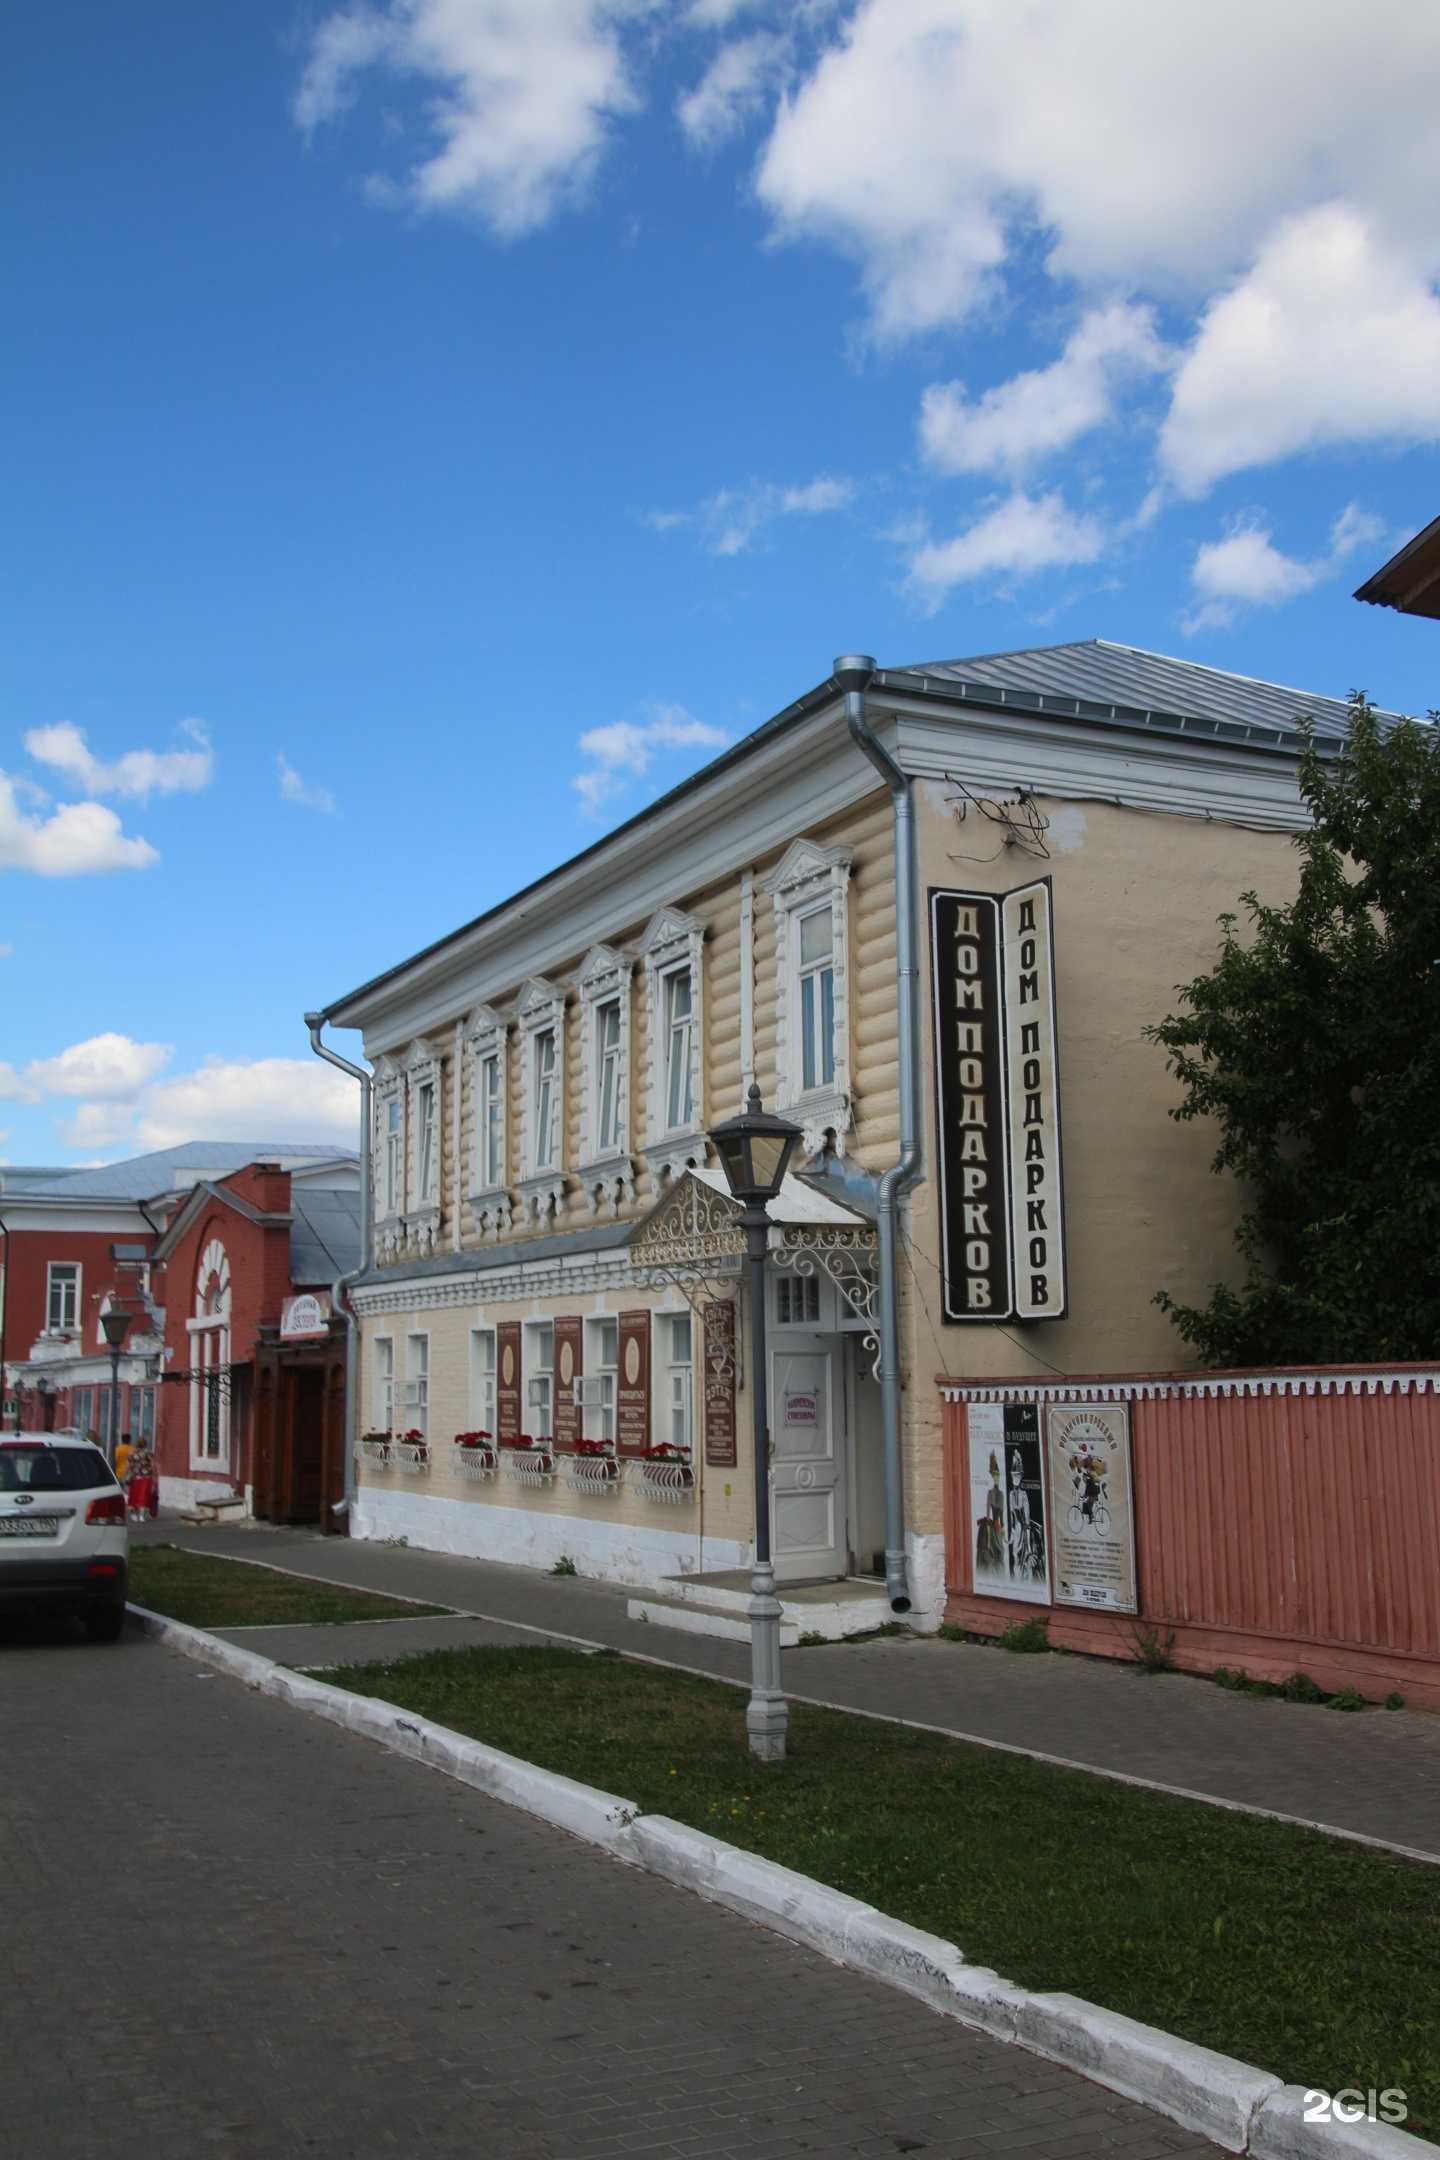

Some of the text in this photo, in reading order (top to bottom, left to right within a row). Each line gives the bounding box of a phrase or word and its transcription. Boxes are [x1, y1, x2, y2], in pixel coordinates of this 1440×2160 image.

[954, 905, 992, 1310] ДОМ ПОДАРКОВ
[1018, 899, 1050, 1306] ДОМ ПОДАРКОВ
